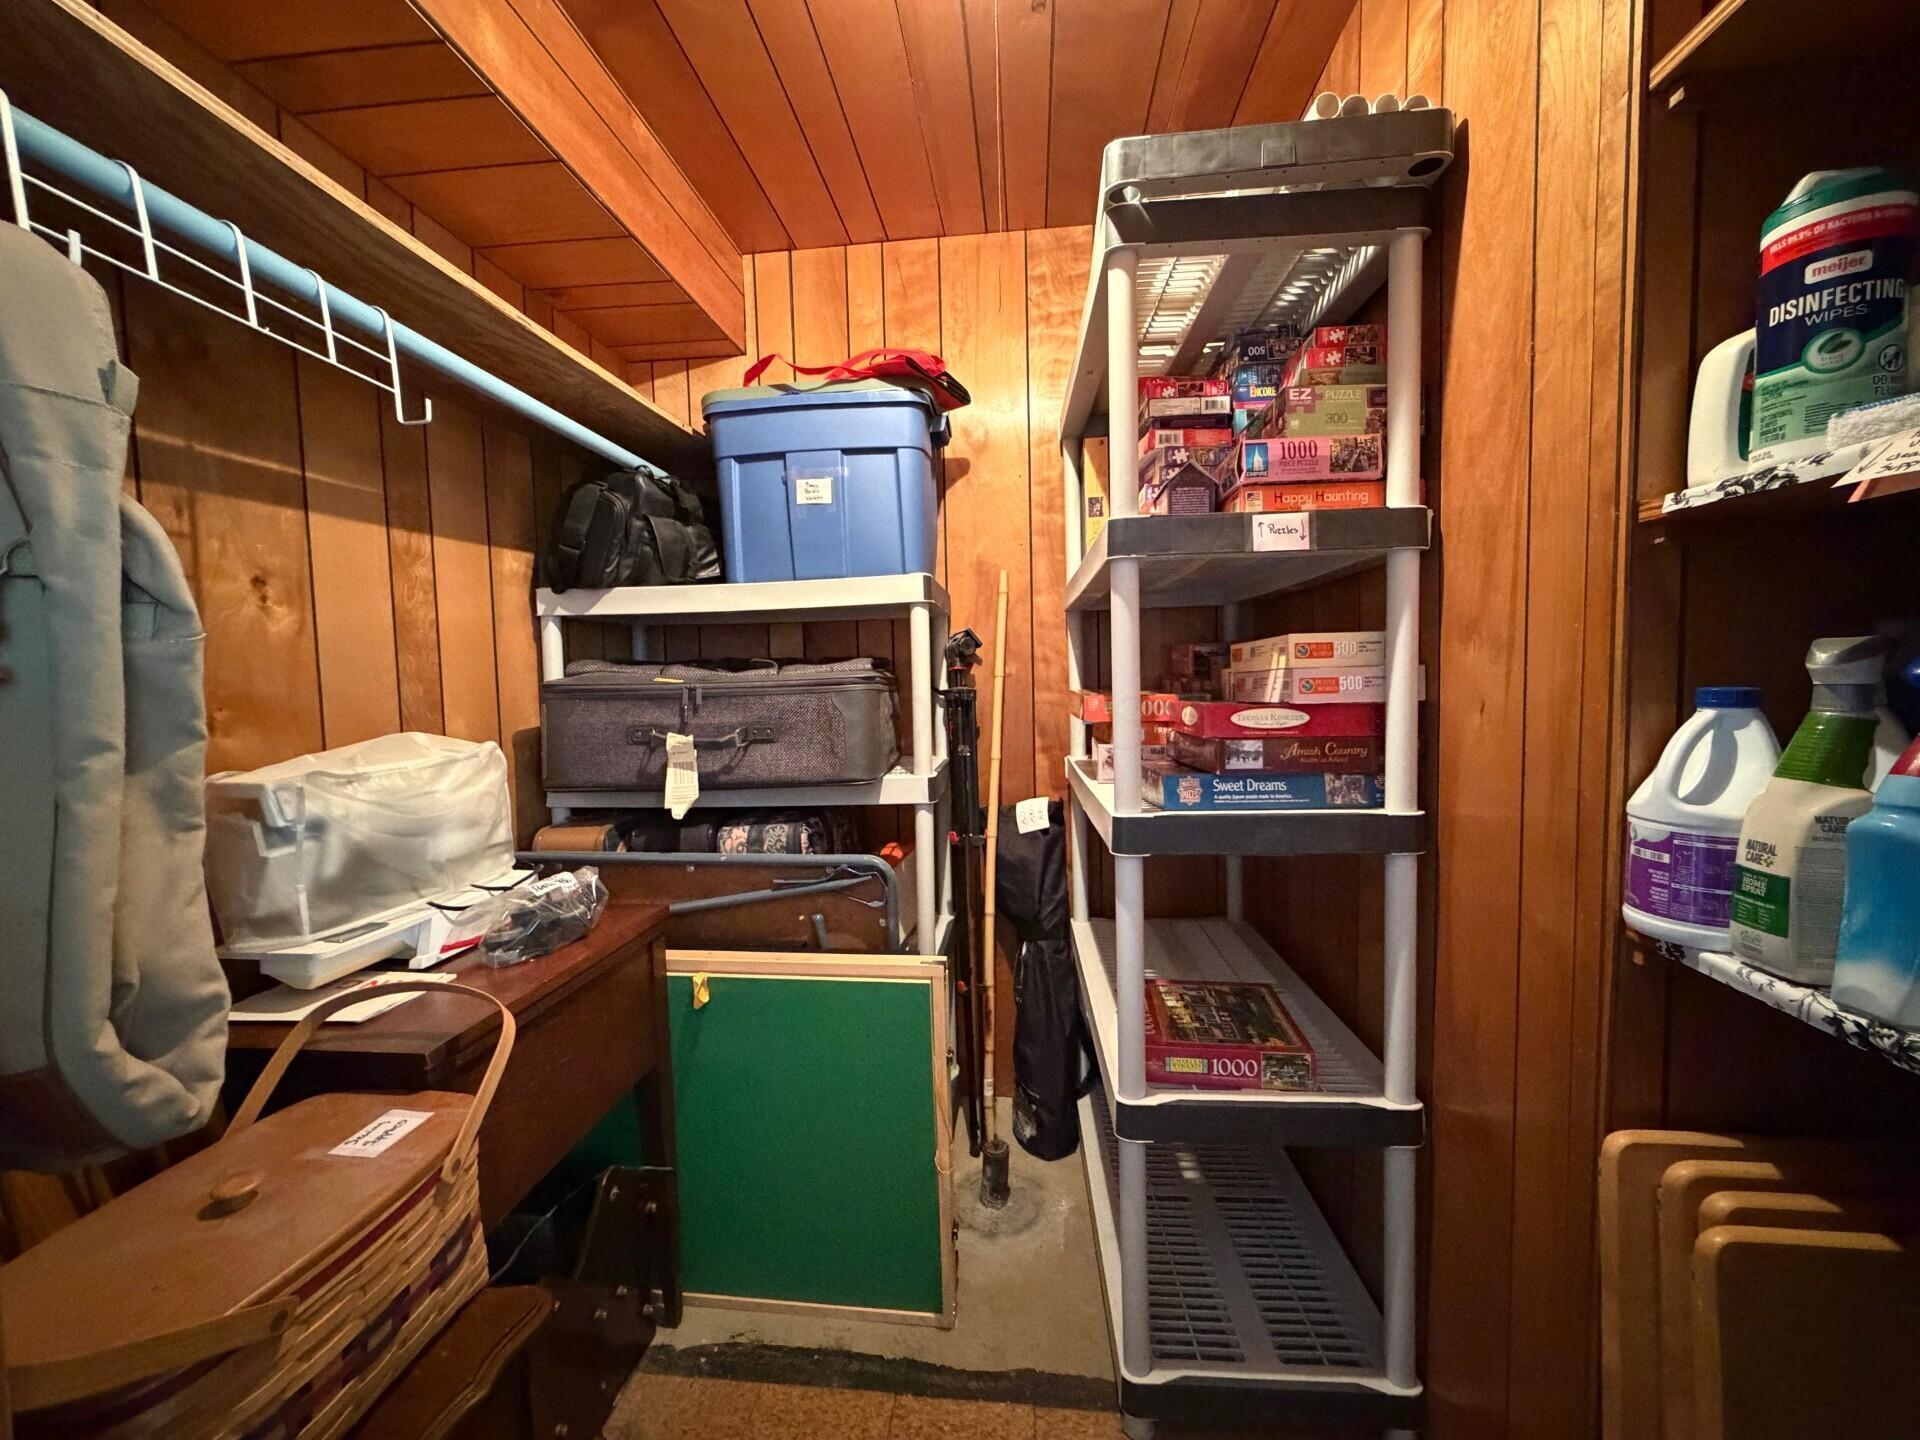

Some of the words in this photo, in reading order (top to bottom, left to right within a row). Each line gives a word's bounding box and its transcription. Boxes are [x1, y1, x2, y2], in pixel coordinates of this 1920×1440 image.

[1811, 255, 1867, 278] meijer
[1768, 277, 1906, 328] DISINFECTING
[1804, 303, 1869, 327] WIPES
[1249, 386, 1277, 398] ENCORE
[1289, 388, 1313, 400] EZ
[1325, 389, 1362, 400] PUZZLE
[1325, 412, 1348, 424] 300
[1280, 440, 1318, 460] 1000
[1274, 491, 1313, 505] Happy
[1315, 490, 1369, 505] Haunting
[1267, 523, 1299, 535] Puzzles
[1335, 641, 1357, 657] 500
[1340, 676, 1363, 691] 500
[1325, 741, 1369, 757] Country
[1212, 778, 1245, 792] Sweet
[1246, 778, 1288, 792] Dreams
[1746, 839, 1778, 857] NATURAL
[1745, 851, 1764, 866] CARE
[1743, 876, 1767, 890] HOME
[1211, 1056, 1258, 1077] 1000
